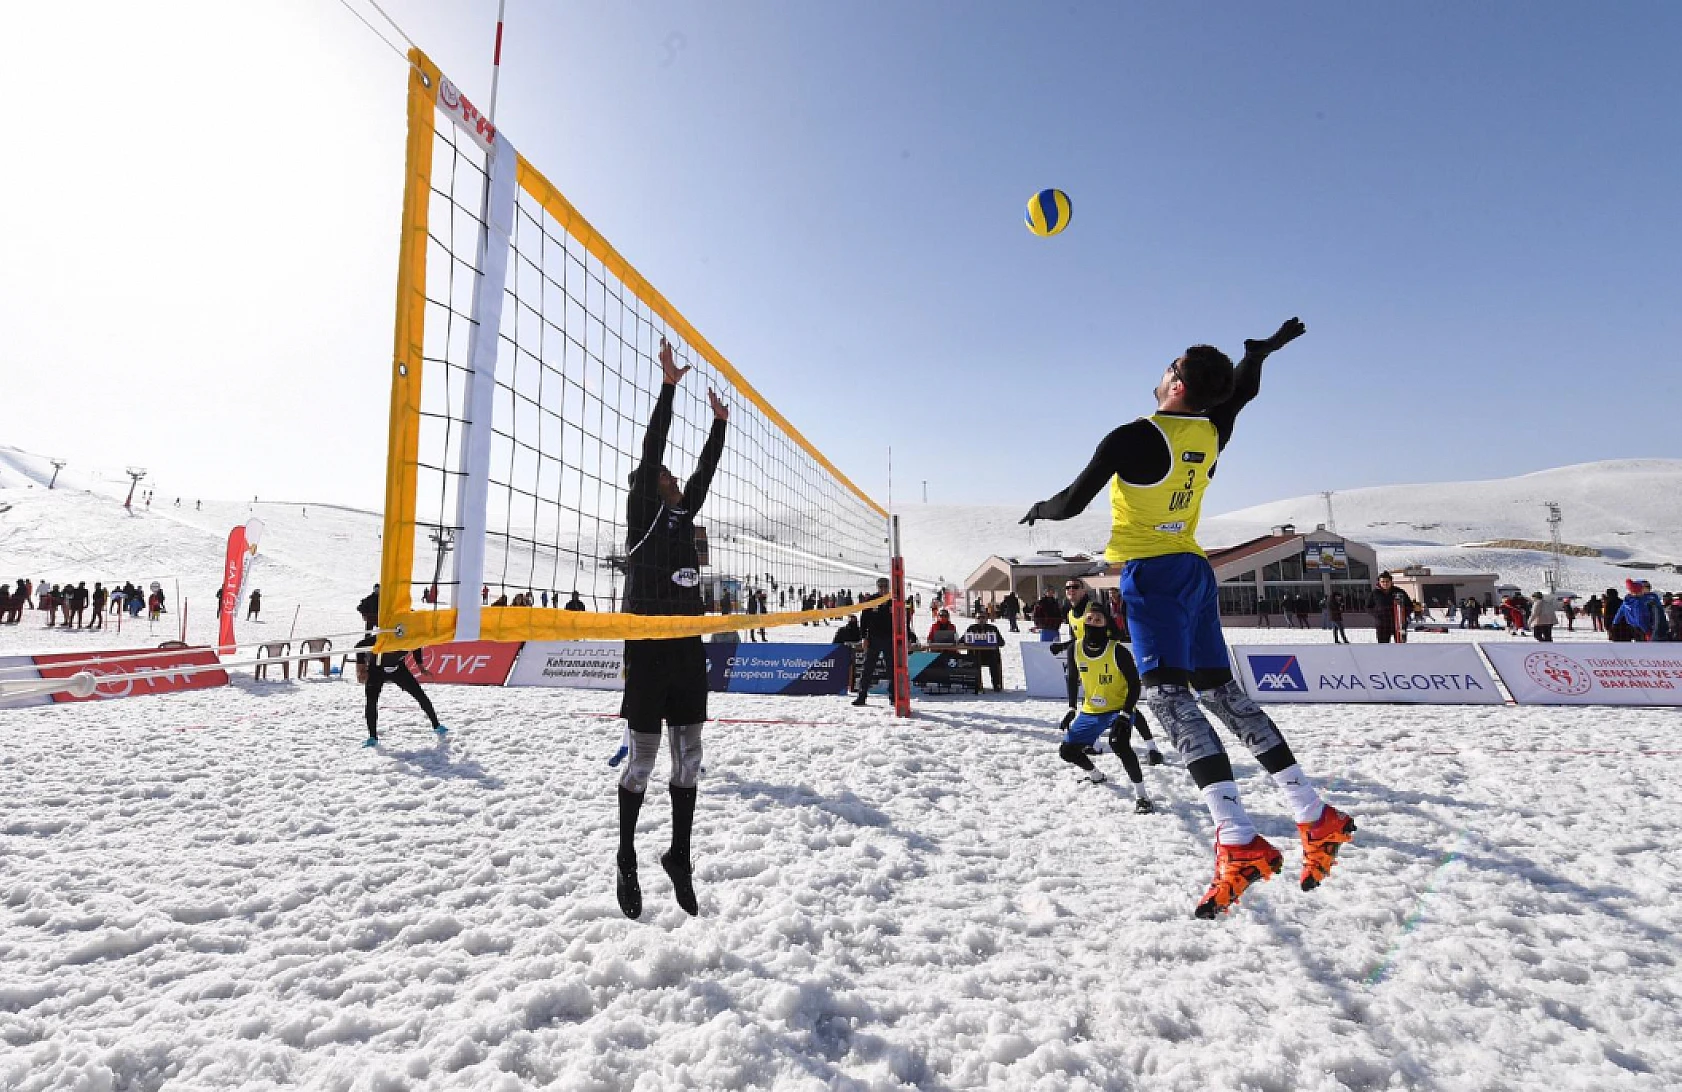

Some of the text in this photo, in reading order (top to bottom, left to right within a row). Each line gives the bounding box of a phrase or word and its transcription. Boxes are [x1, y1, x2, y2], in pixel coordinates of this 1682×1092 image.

[1185, 469, 1196, 489] 3
[1169, 490, 1194, 511] UKR
[437, 655, 492, 674] TVF
[546, 657, 621, 669] Kahramanmaraş
[726, 657, 836, 669] CEV Snow Volleyball
[723, 668, 830, 681] European Tour 2022
[1257, 673, 1299, 689] AXA
[1319, 671, 1484, 690] AXA SİGORTA
[1652, 670, 1672, 679] VE
